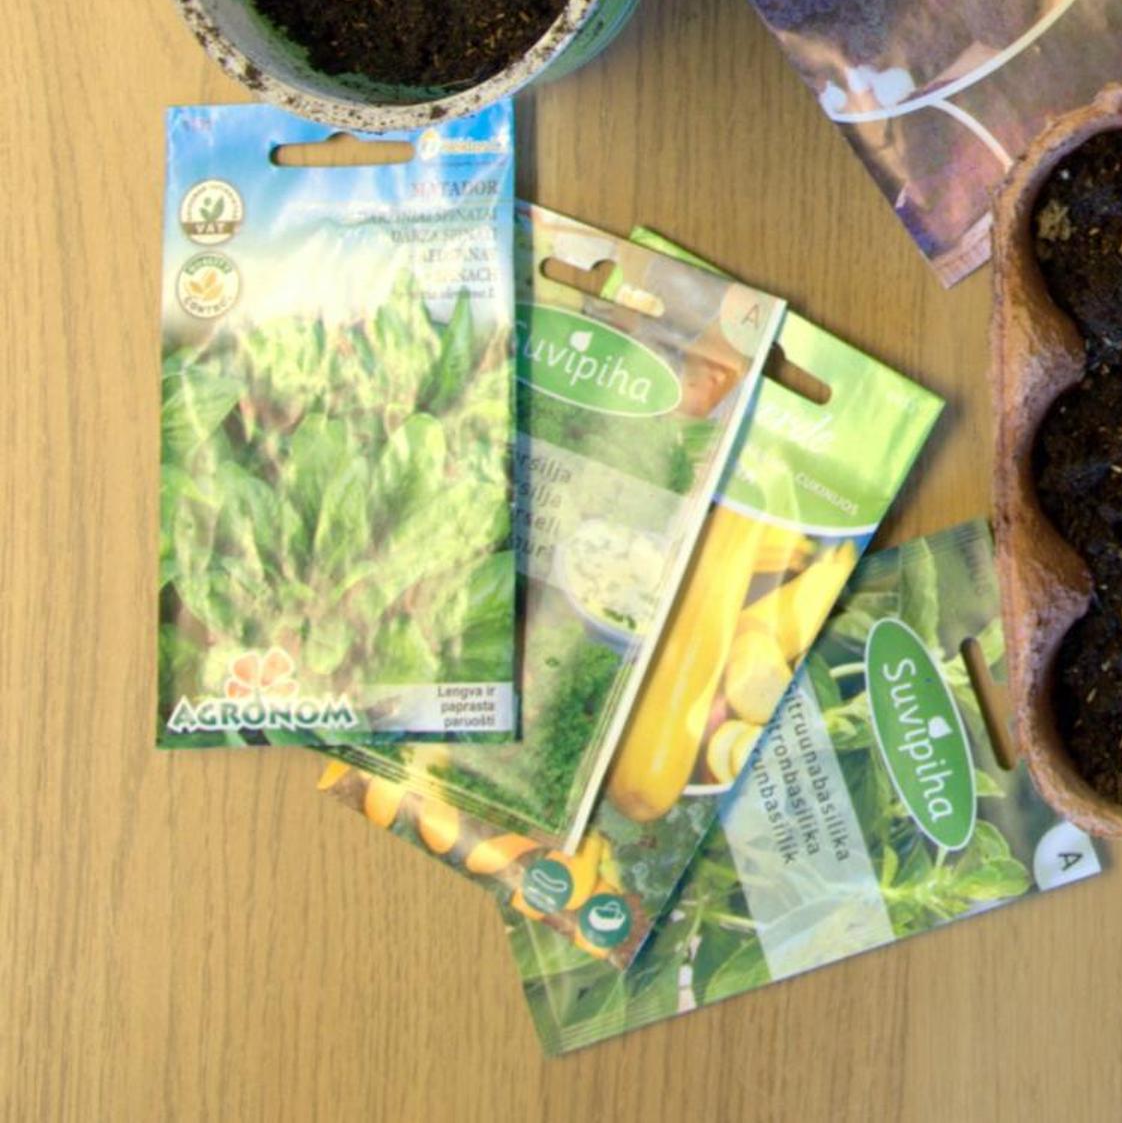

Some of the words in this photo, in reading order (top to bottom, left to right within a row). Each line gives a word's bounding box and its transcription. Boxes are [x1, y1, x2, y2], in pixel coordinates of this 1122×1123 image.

[437, 685, 482, 700] Lengva
[486, 685, 496, 695] ir
[168, 695, 356, 729] AGRONOM
[441, 701, 495, 716] paprasta
[882, 656, 953, 821] Suvipiha
[745, 744, 797, 867] runbasiilik
[1058, 852, 1083, 871] A
